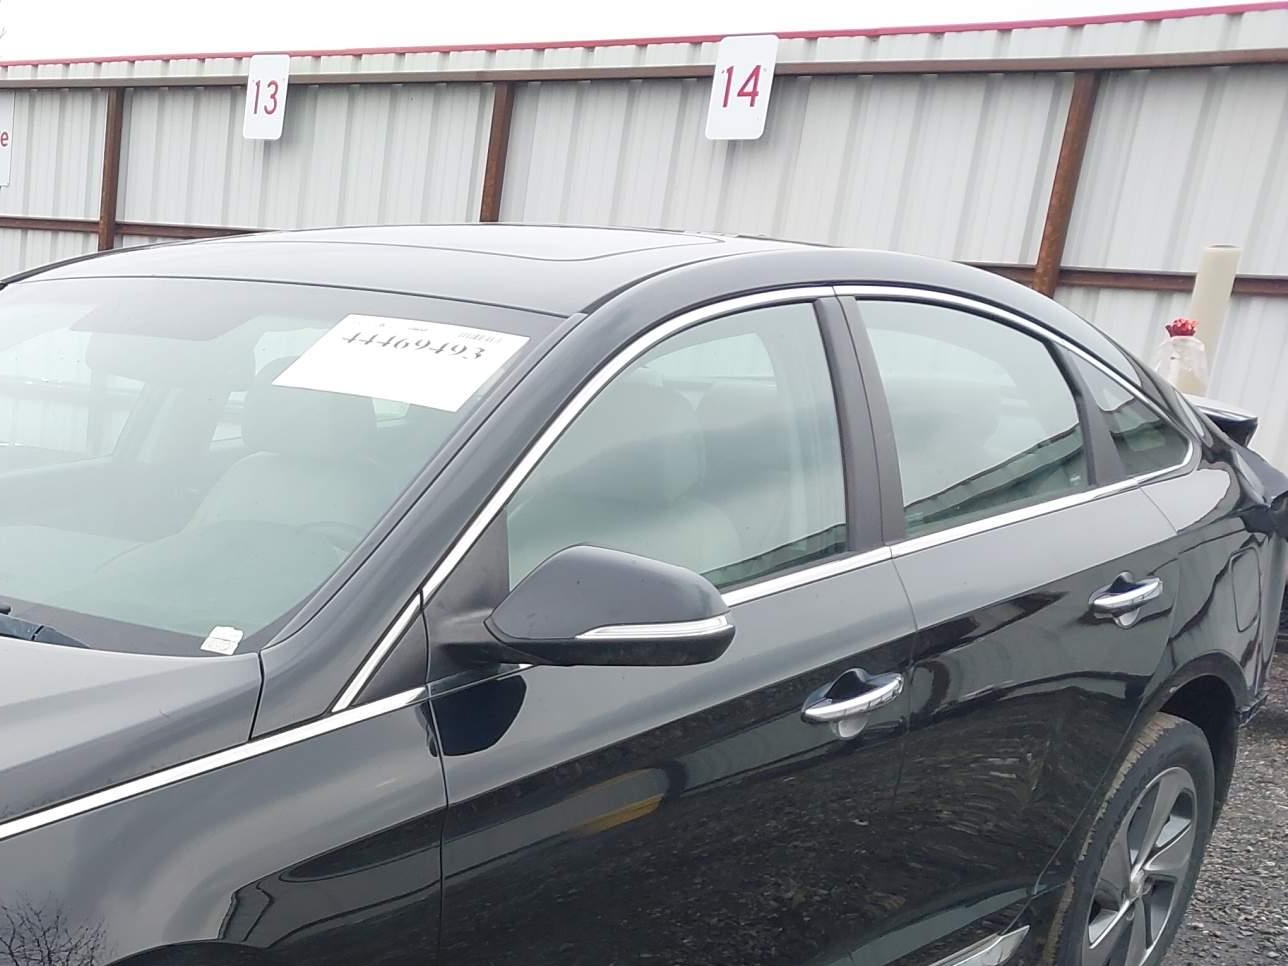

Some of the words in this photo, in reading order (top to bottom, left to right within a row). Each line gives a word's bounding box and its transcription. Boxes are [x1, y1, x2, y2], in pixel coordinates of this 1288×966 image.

[253, 79, 279, 115] 13
[722, 64, 761, 108] 14
[342, 331, 486, 360] 44469493
